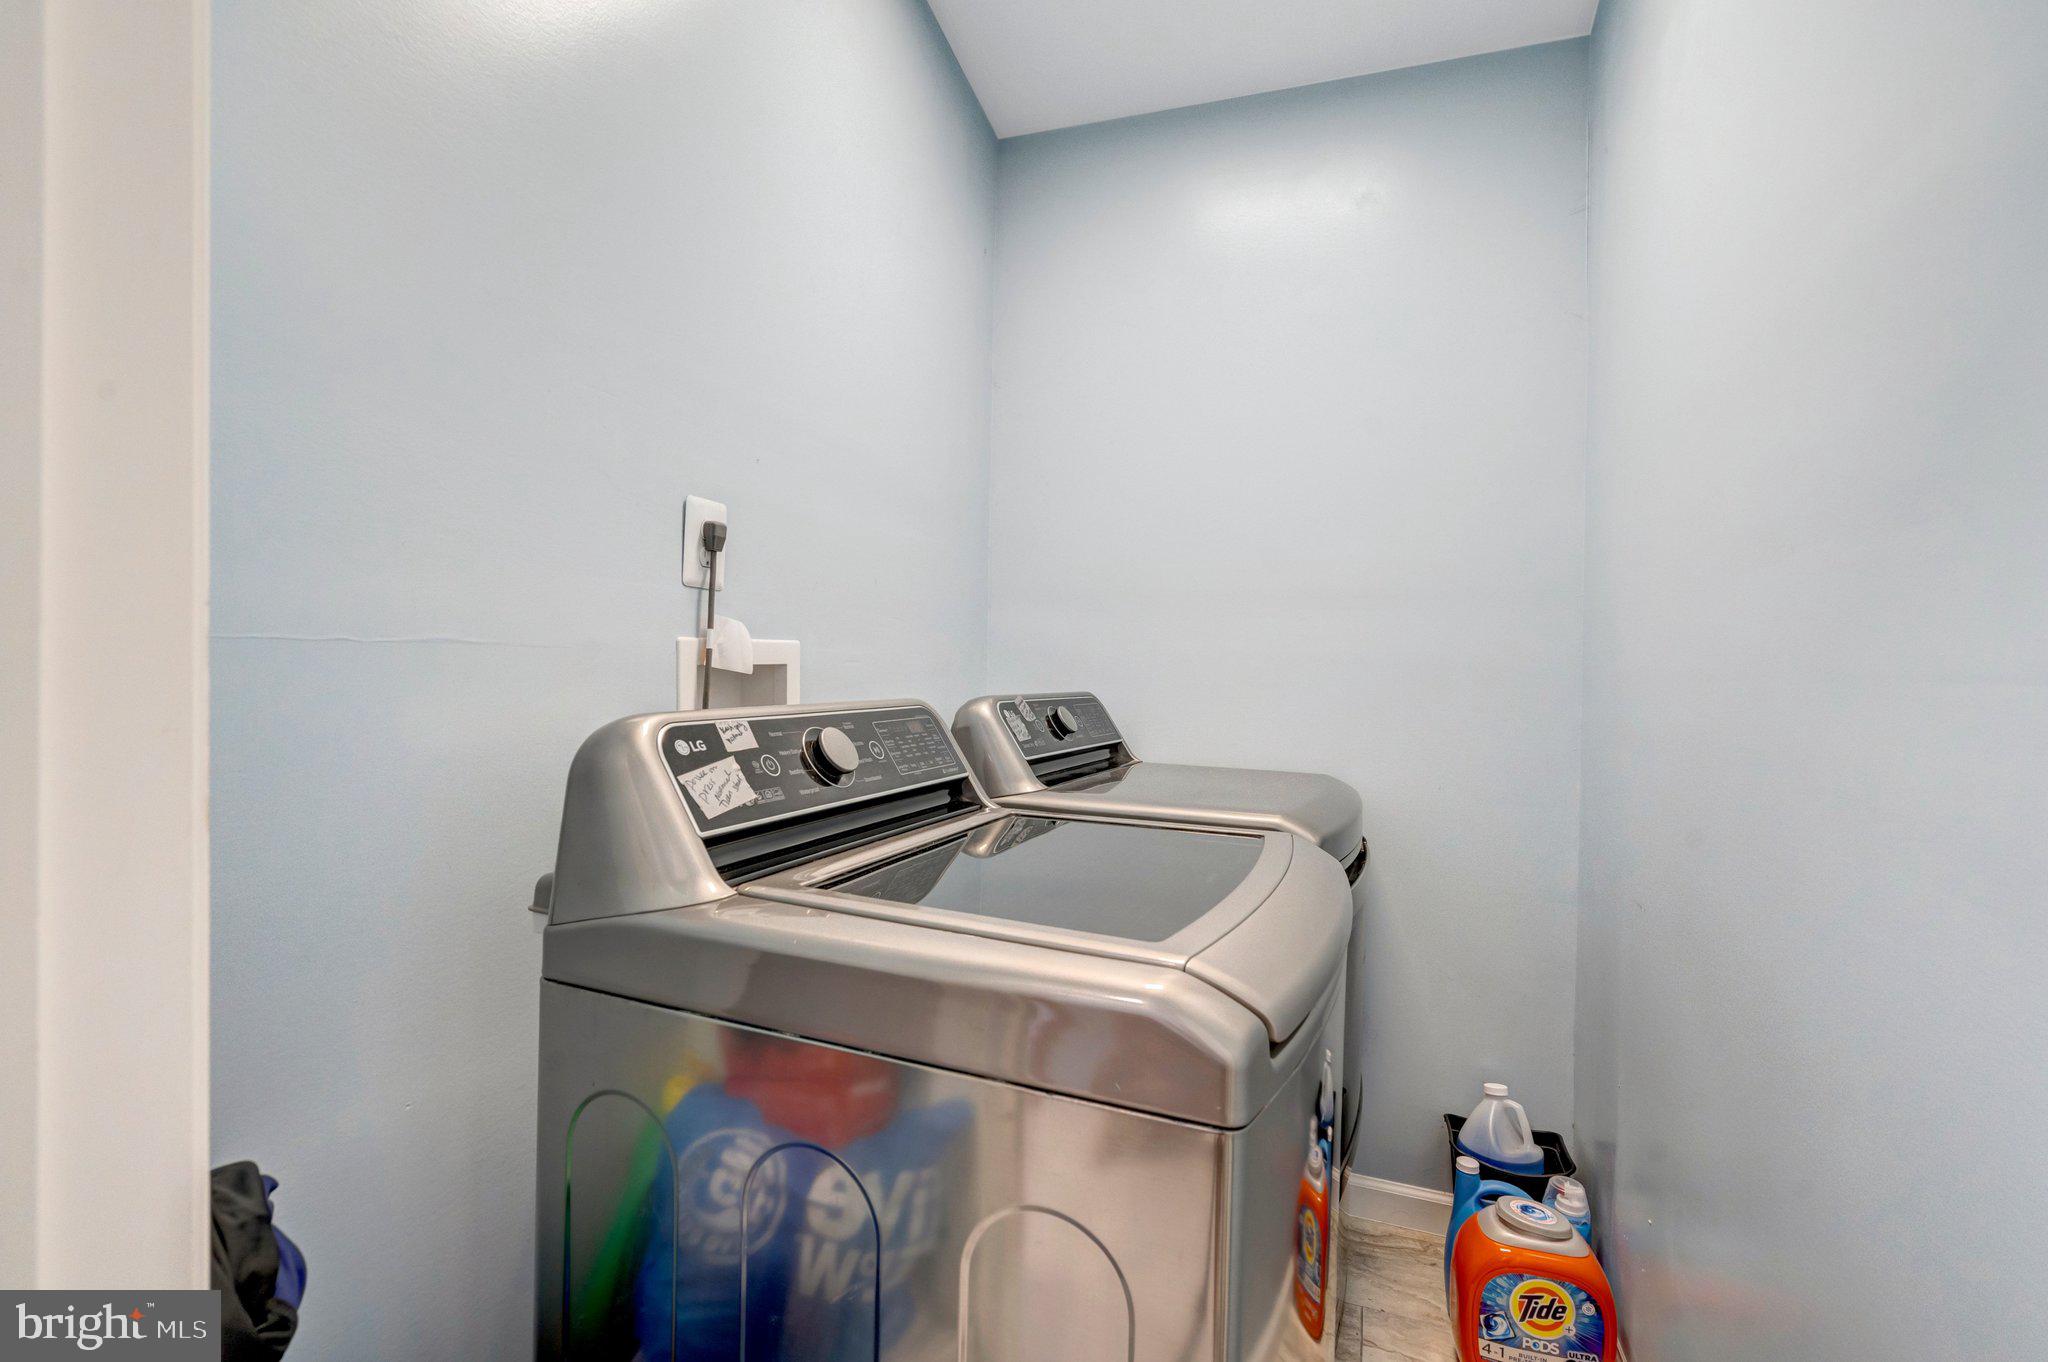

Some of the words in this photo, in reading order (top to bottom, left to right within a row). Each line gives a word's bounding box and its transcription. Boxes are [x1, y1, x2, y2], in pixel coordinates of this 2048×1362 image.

[689, 740, 707, 752] LG
[1519, 1294, 1568, 1323] Tide
[1522, 1337, 1560, 1355] PODS
[1568, 1352, 1597, 1362] ULTRA
